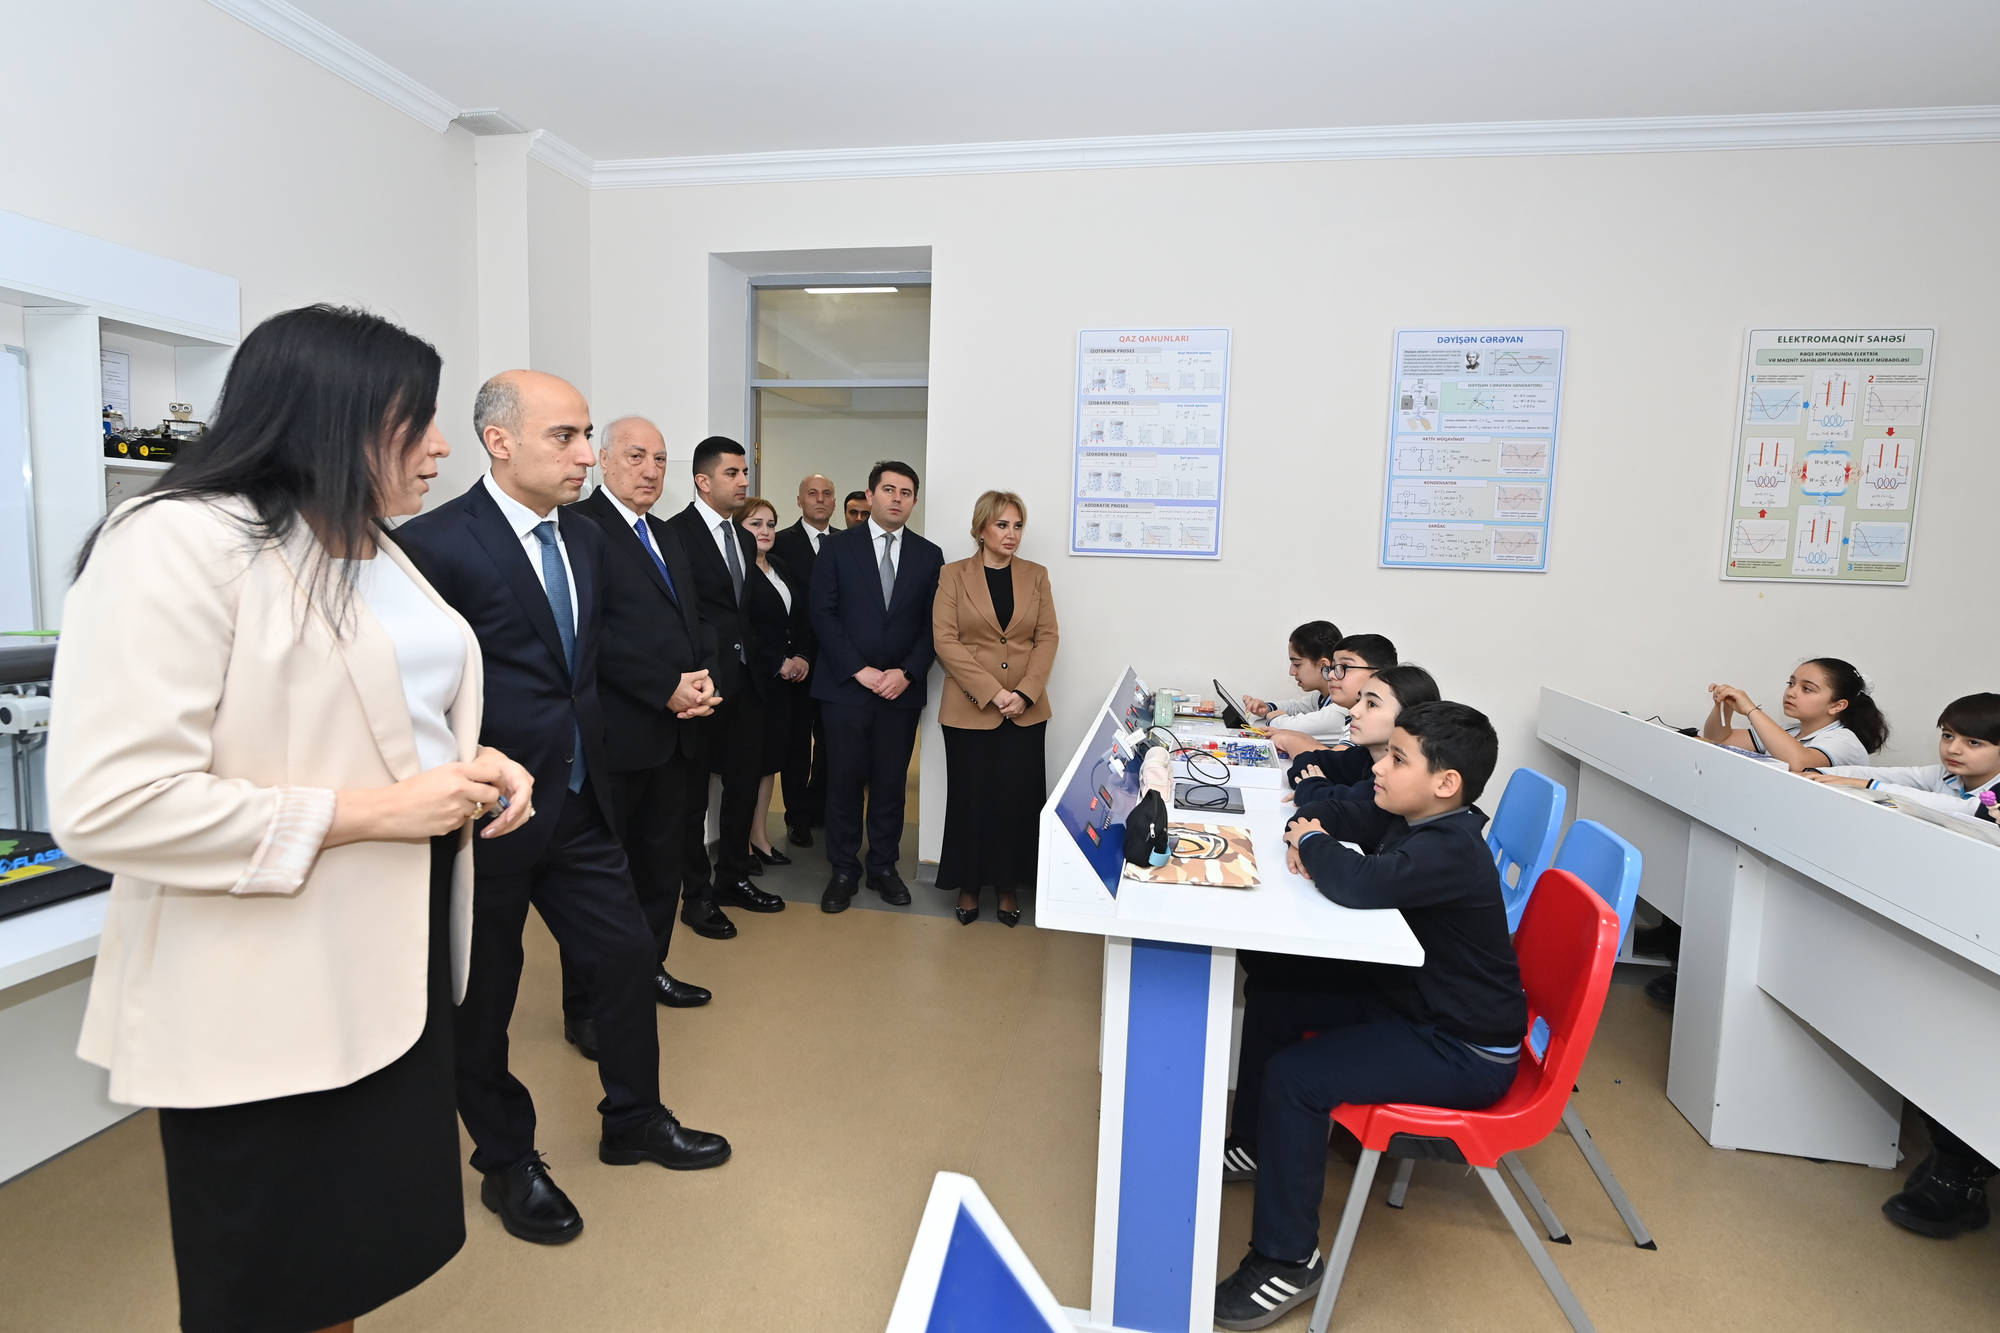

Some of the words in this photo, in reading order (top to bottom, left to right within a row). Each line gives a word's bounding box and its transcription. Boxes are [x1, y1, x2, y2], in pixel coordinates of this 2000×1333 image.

[1437, 336, 1477, 344] DƏYİŞƏN
[1480, 336, 1524, 344] CƏRƏYAN
[1777, 335, 1864, 344] ELEKTROMAQNİT
[1867, 334, 1906, 343] SAHƏSİ
